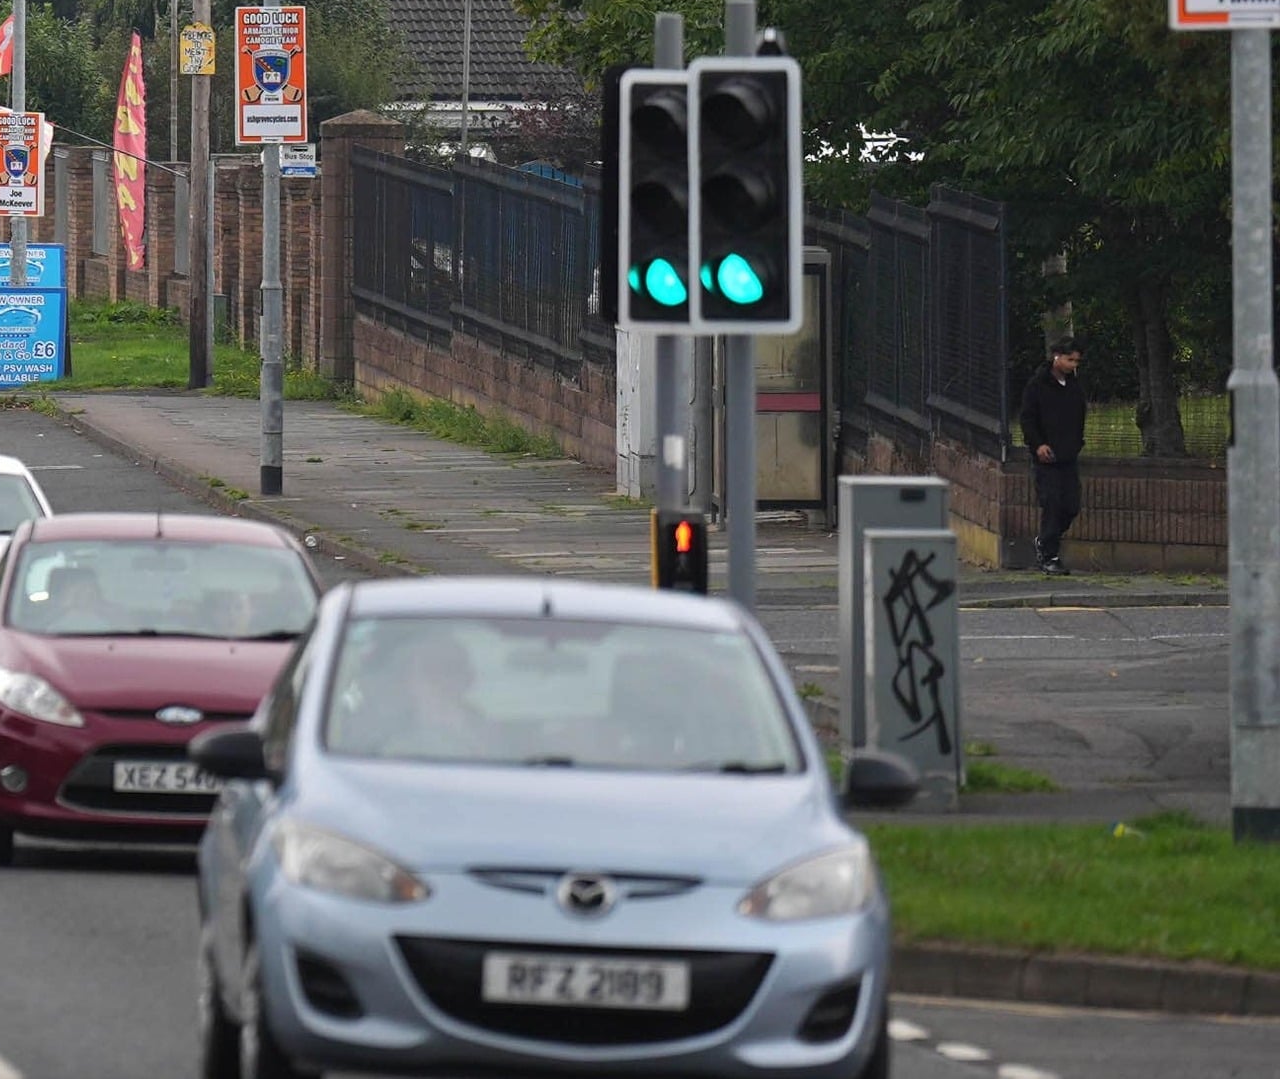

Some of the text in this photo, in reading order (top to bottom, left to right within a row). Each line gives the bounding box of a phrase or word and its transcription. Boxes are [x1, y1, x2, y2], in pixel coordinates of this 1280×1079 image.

[243, 13, 299, 24] GOOD LUCK
[243, 27, 299, 35] ARMAGH SENIOR
[246, 36, 297, 44] CAMOGIE TEAM
[18, 117, 36, 126] LUCK
[298, 153, 314, 161] Stop
[9, 189, 22, 198] Joe
[0, 199, 33, 208] McKeever
[8, 296, 44, 305] OWNER
[33, 342, 55, 358] £6
[4, 351, 12, 360] &
[15, 350, 31, 360] Go
[4, 364, 22, 373] PSV
[25, 364, 53, 373] WASH
[124, 766, 167, 789] XEZ
[506, 963, 575, 999] RFZ
